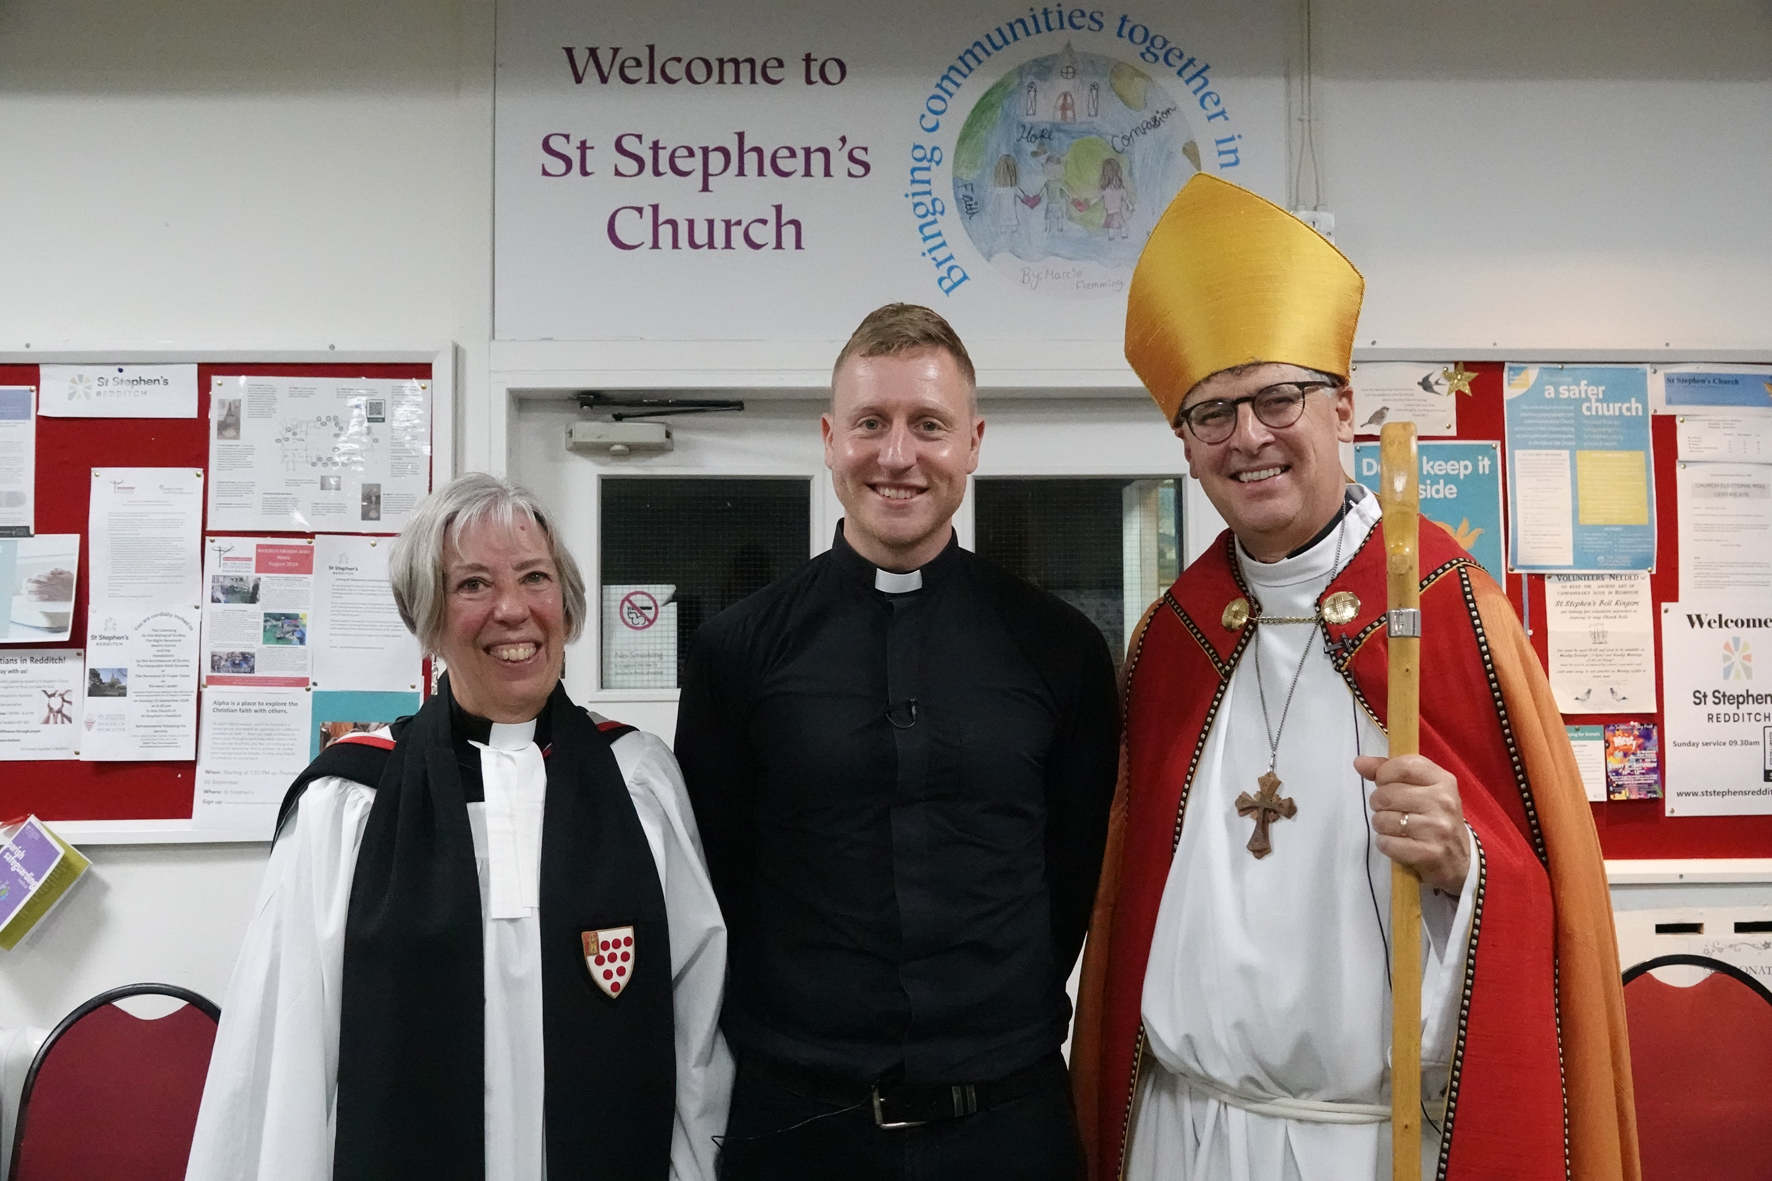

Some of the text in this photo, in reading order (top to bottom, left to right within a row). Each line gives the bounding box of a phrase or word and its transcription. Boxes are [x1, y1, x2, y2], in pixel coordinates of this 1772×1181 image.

[562, 44, 848, 86] Welcome to
[904, 3, 1242, 297] Bringing communities together in
[541, 130, 872, 193] St Stephen's
[607, 203, 806, 251] Church
[97, 376, 169, 389] St Stephen's
[1544, 380, 1606, 399] a safer
[1713, 378, 1740, 387] Church
[1581, 397, 1643, 416] church
[1422, 456, 1473, 479] keep
[1478, 456, 1491, 474] it
[1686, 613, 1772, 629] Welcome
[99, 634, 129, 642] Stephen's
[1692, 690, 1708, 706] St
[1707, 712, 1771, 723] REDDITCH
[1672, 740, 1700, 748] Sunday
